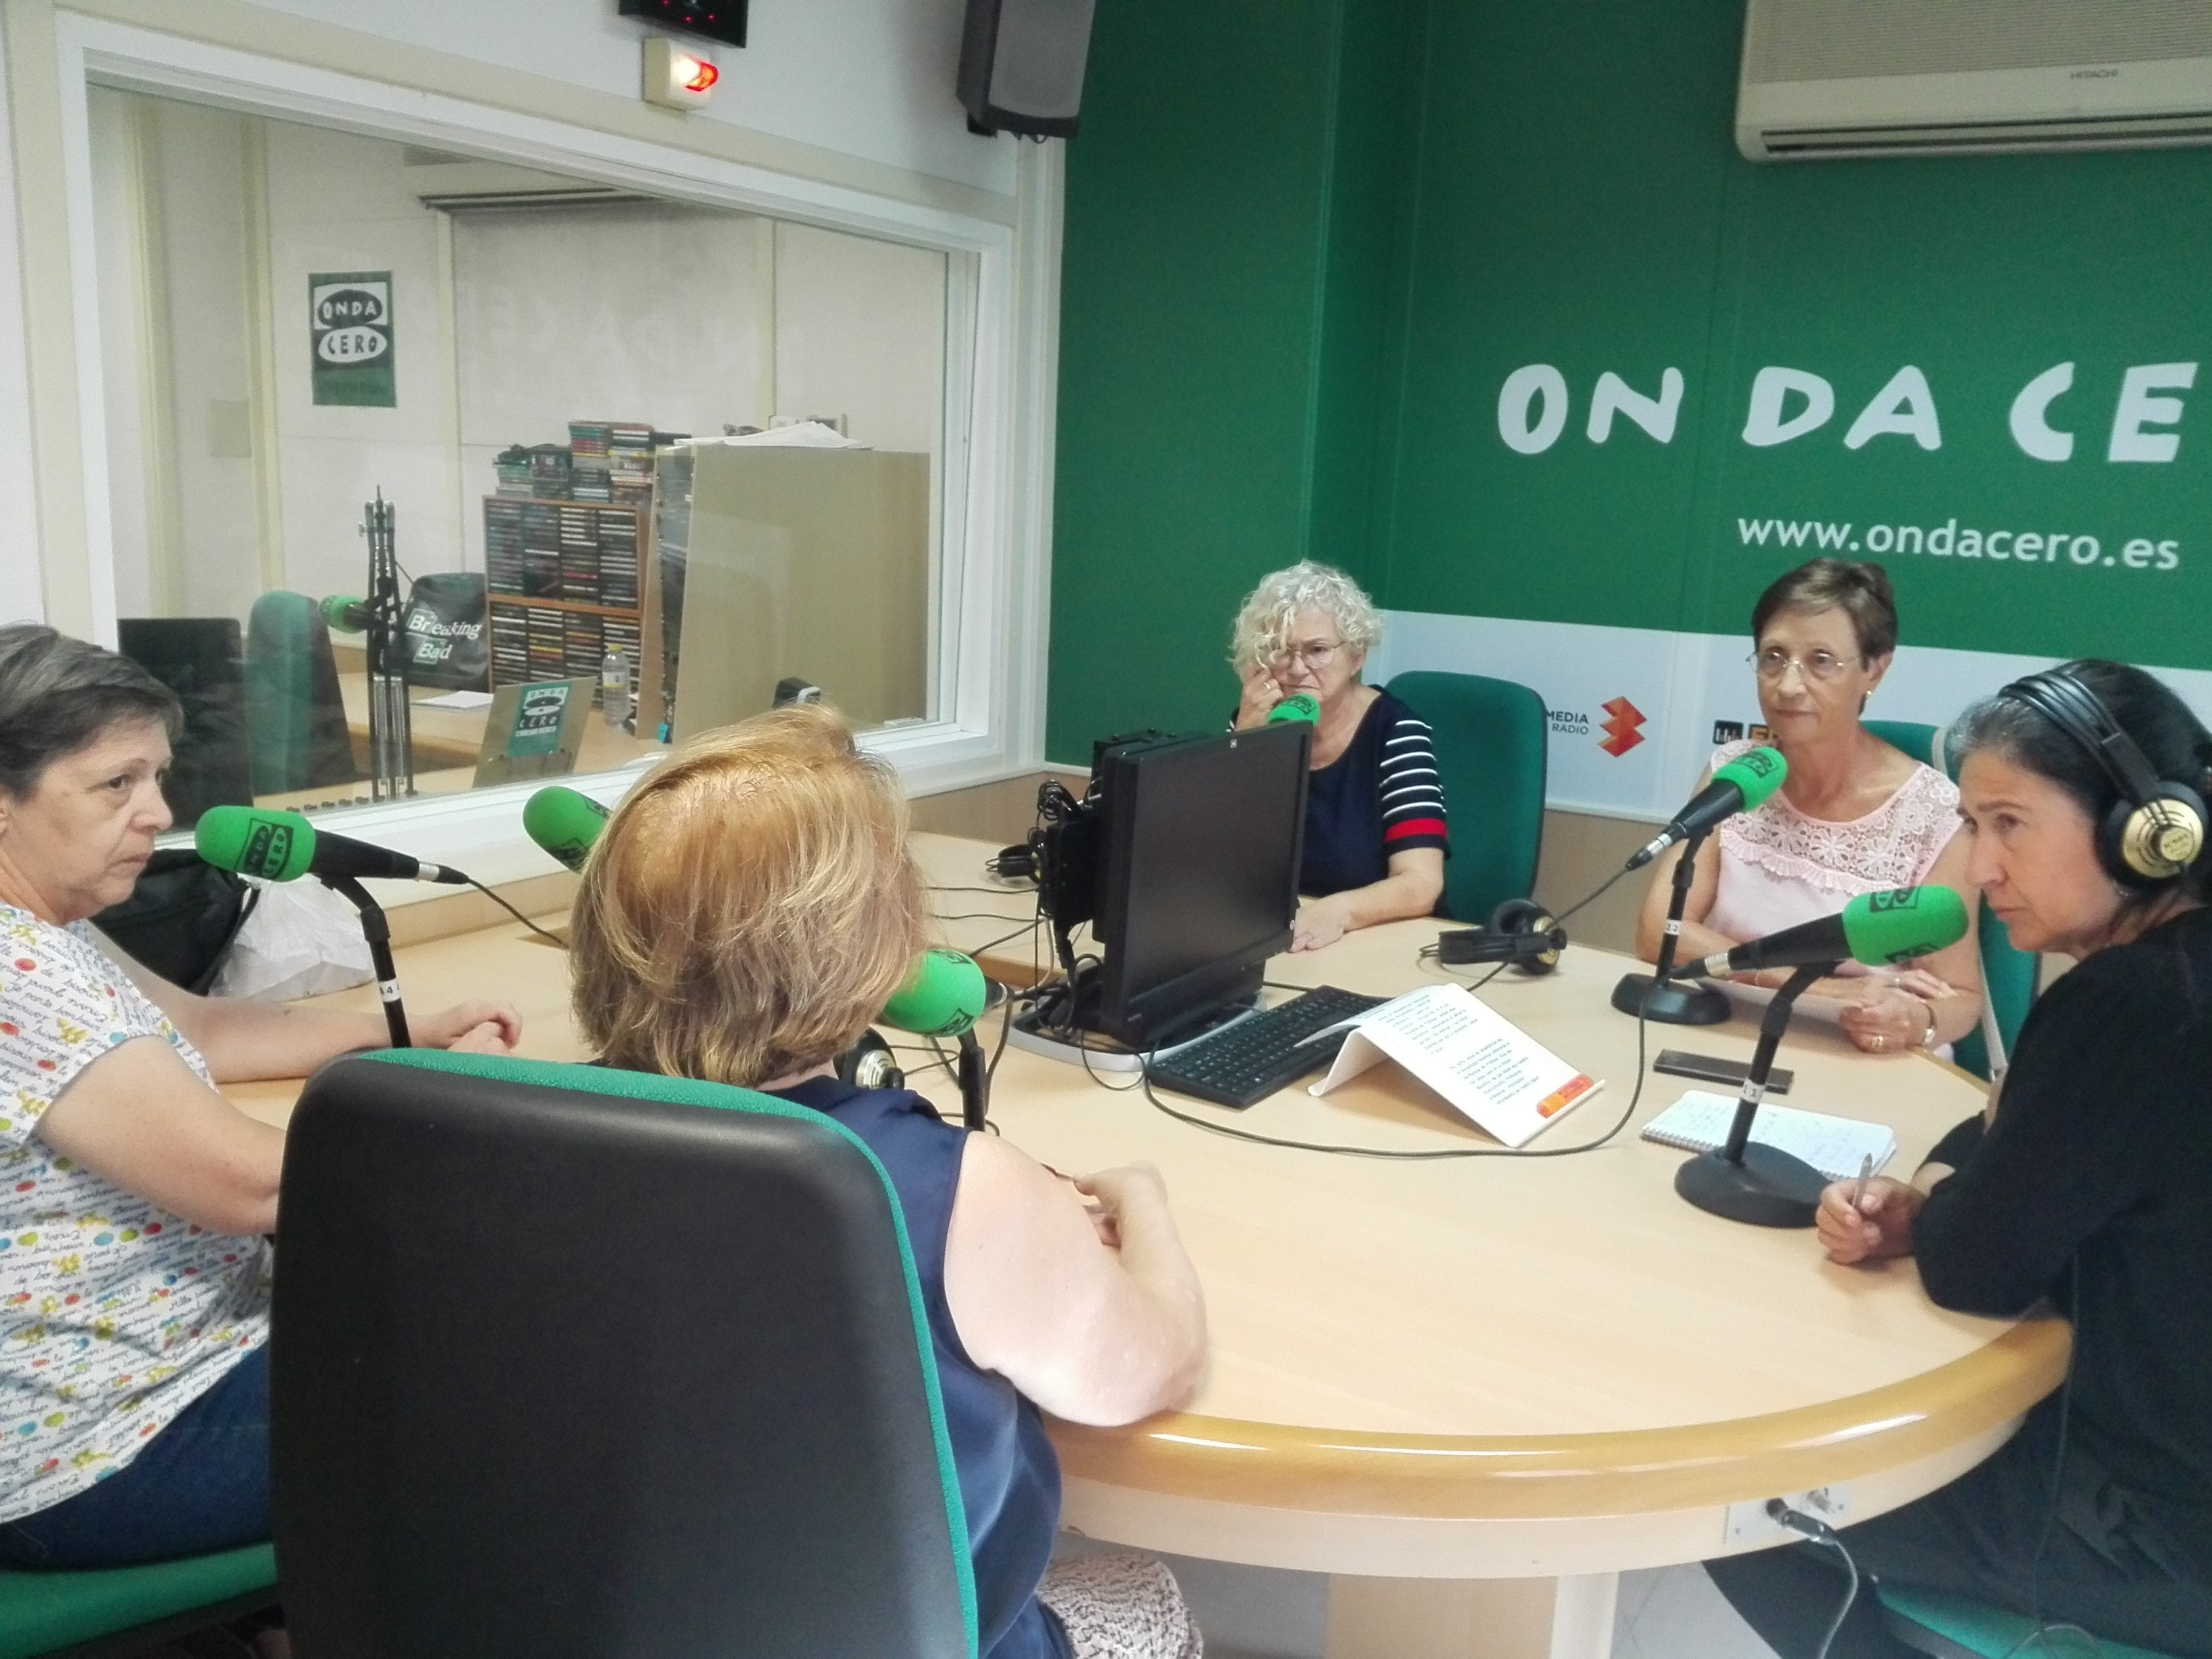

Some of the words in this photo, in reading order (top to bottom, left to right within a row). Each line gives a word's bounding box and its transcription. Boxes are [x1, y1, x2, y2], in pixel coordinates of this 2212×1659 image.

[323, 300, 377, 320] ONDA
[327, 335, 377, 354] CERO
[1738, 516, 2179, 571] www.ondacero.es
[417, 642, 453, 660] Bad
[1552, 723, 1589, 735] RADIO
